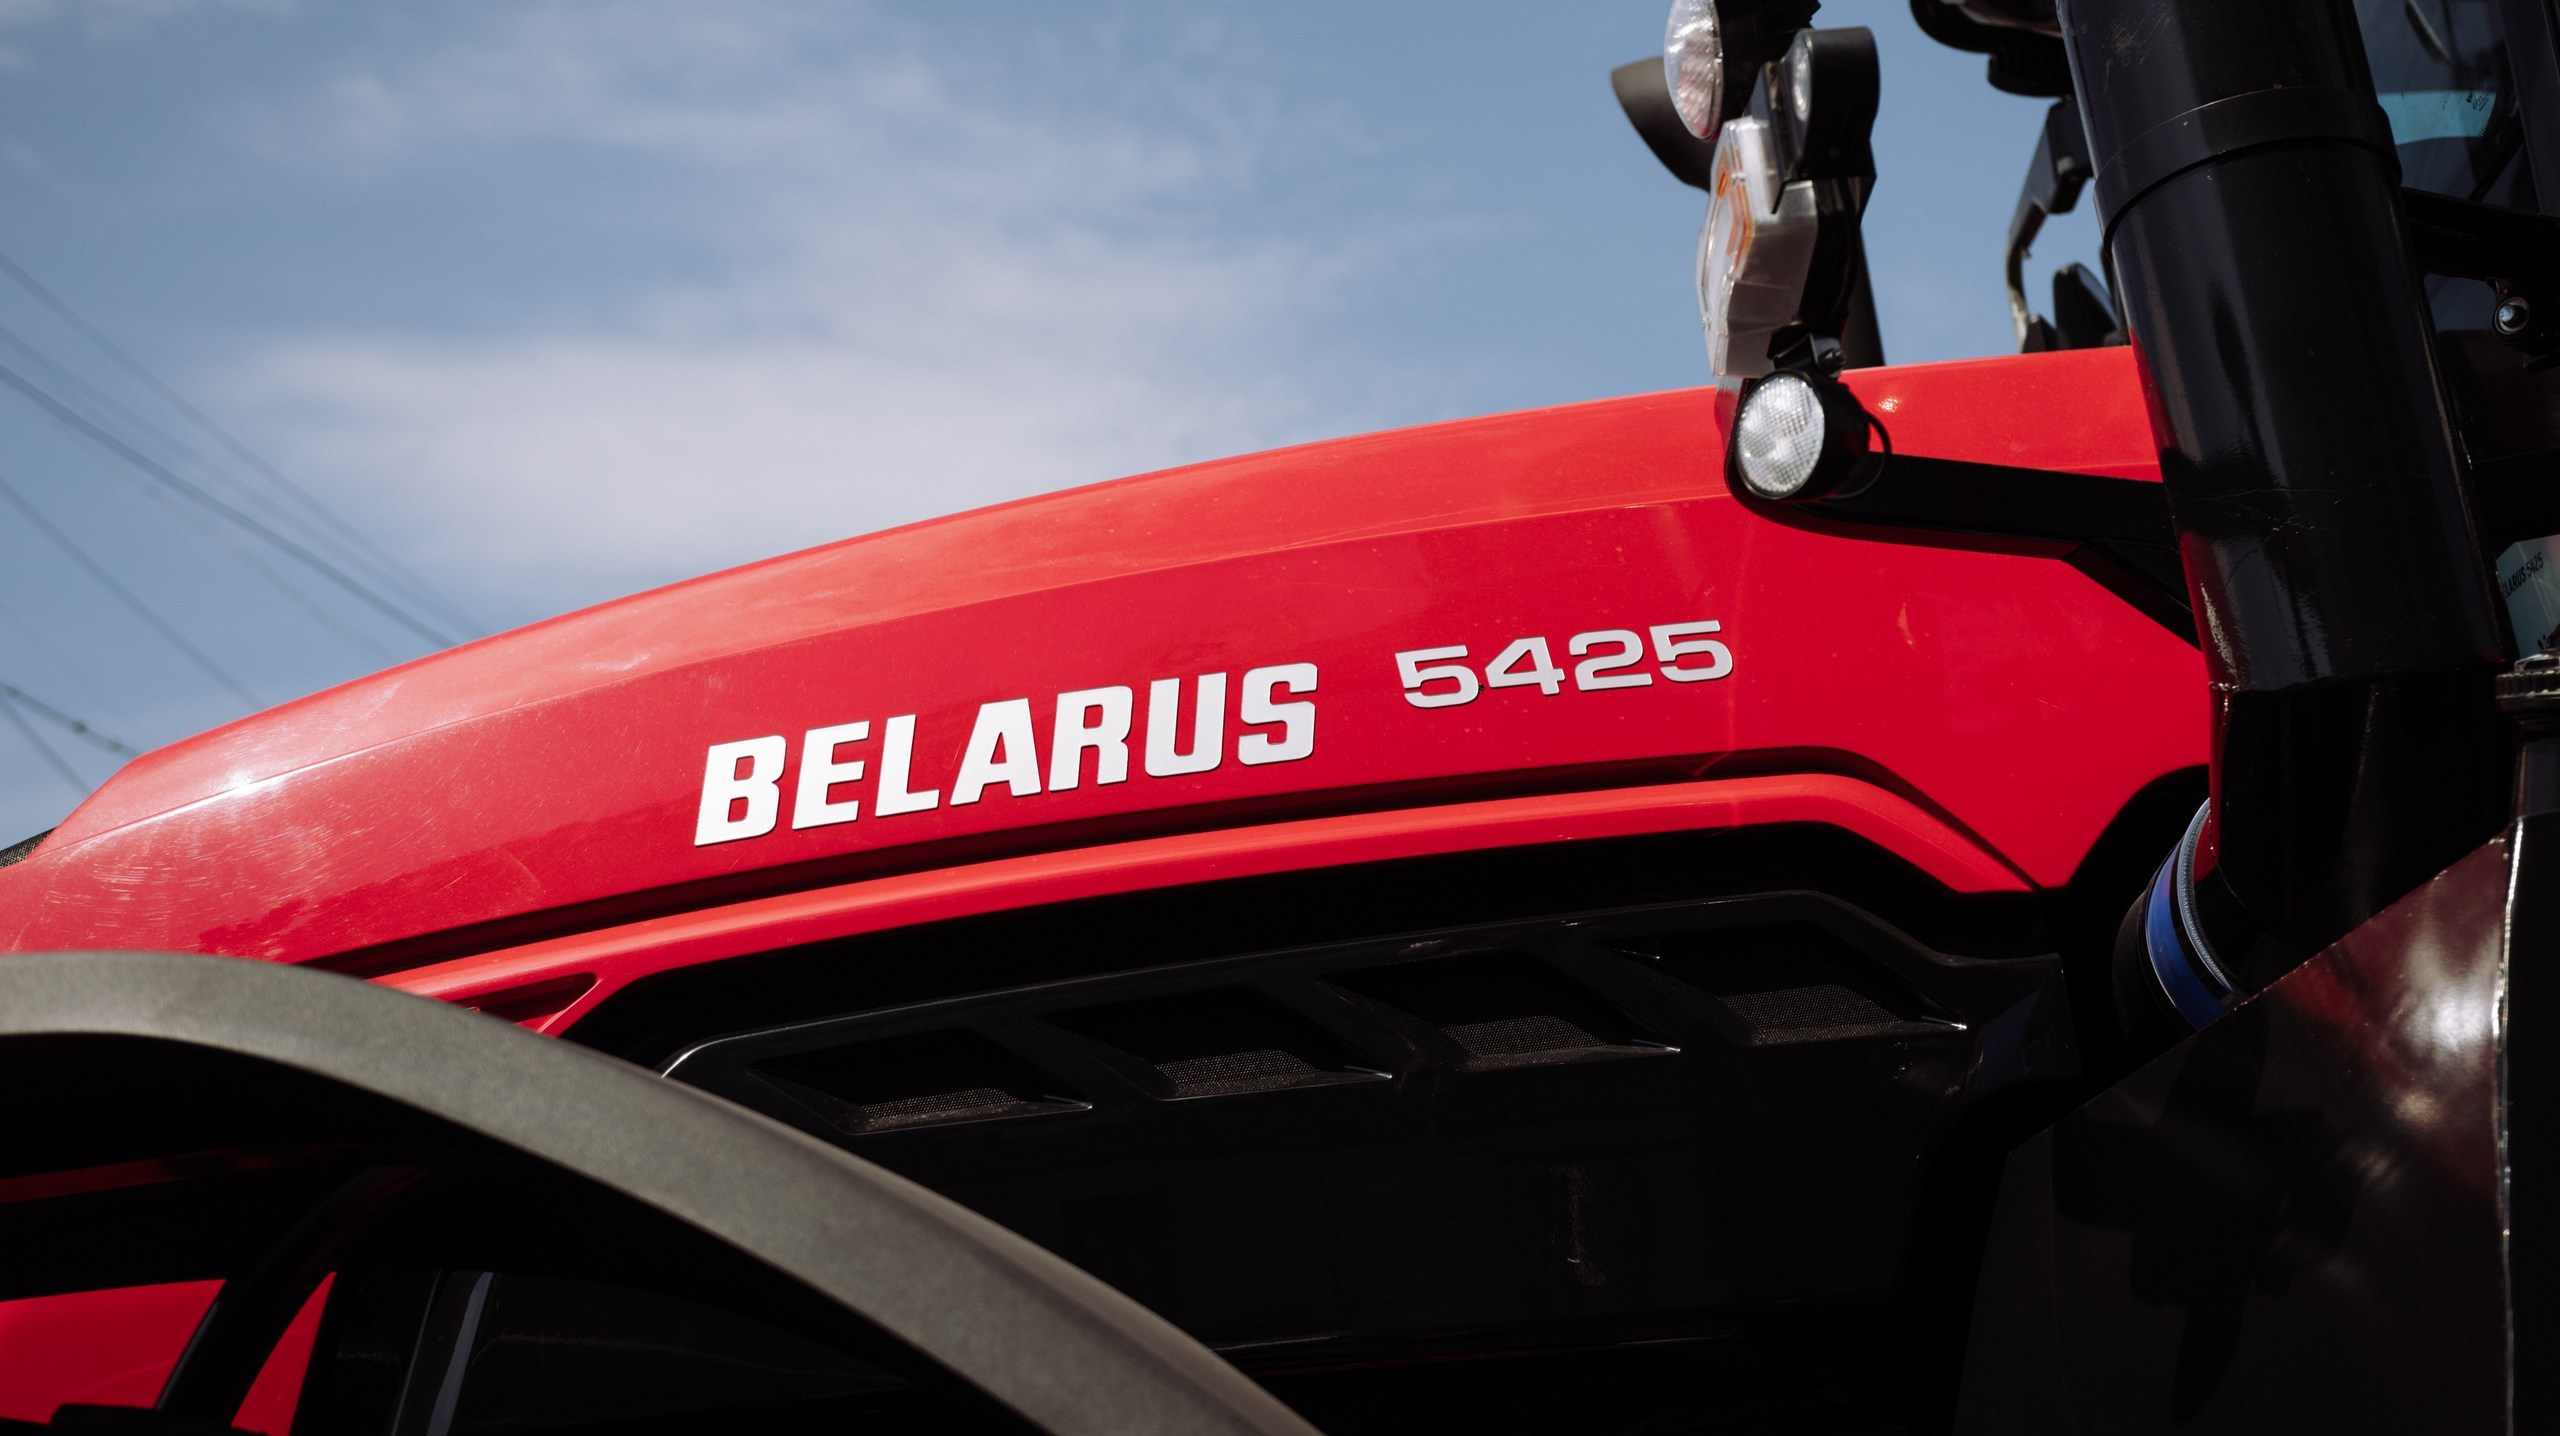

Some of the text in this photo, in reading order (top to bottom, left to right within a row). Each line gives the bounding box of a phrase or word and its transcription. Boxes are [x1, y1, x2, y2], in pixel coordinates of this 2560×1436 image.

[2526, 552, 2544, 578] 5425
[693, 619, 1734, 847] BELARUS 5425
